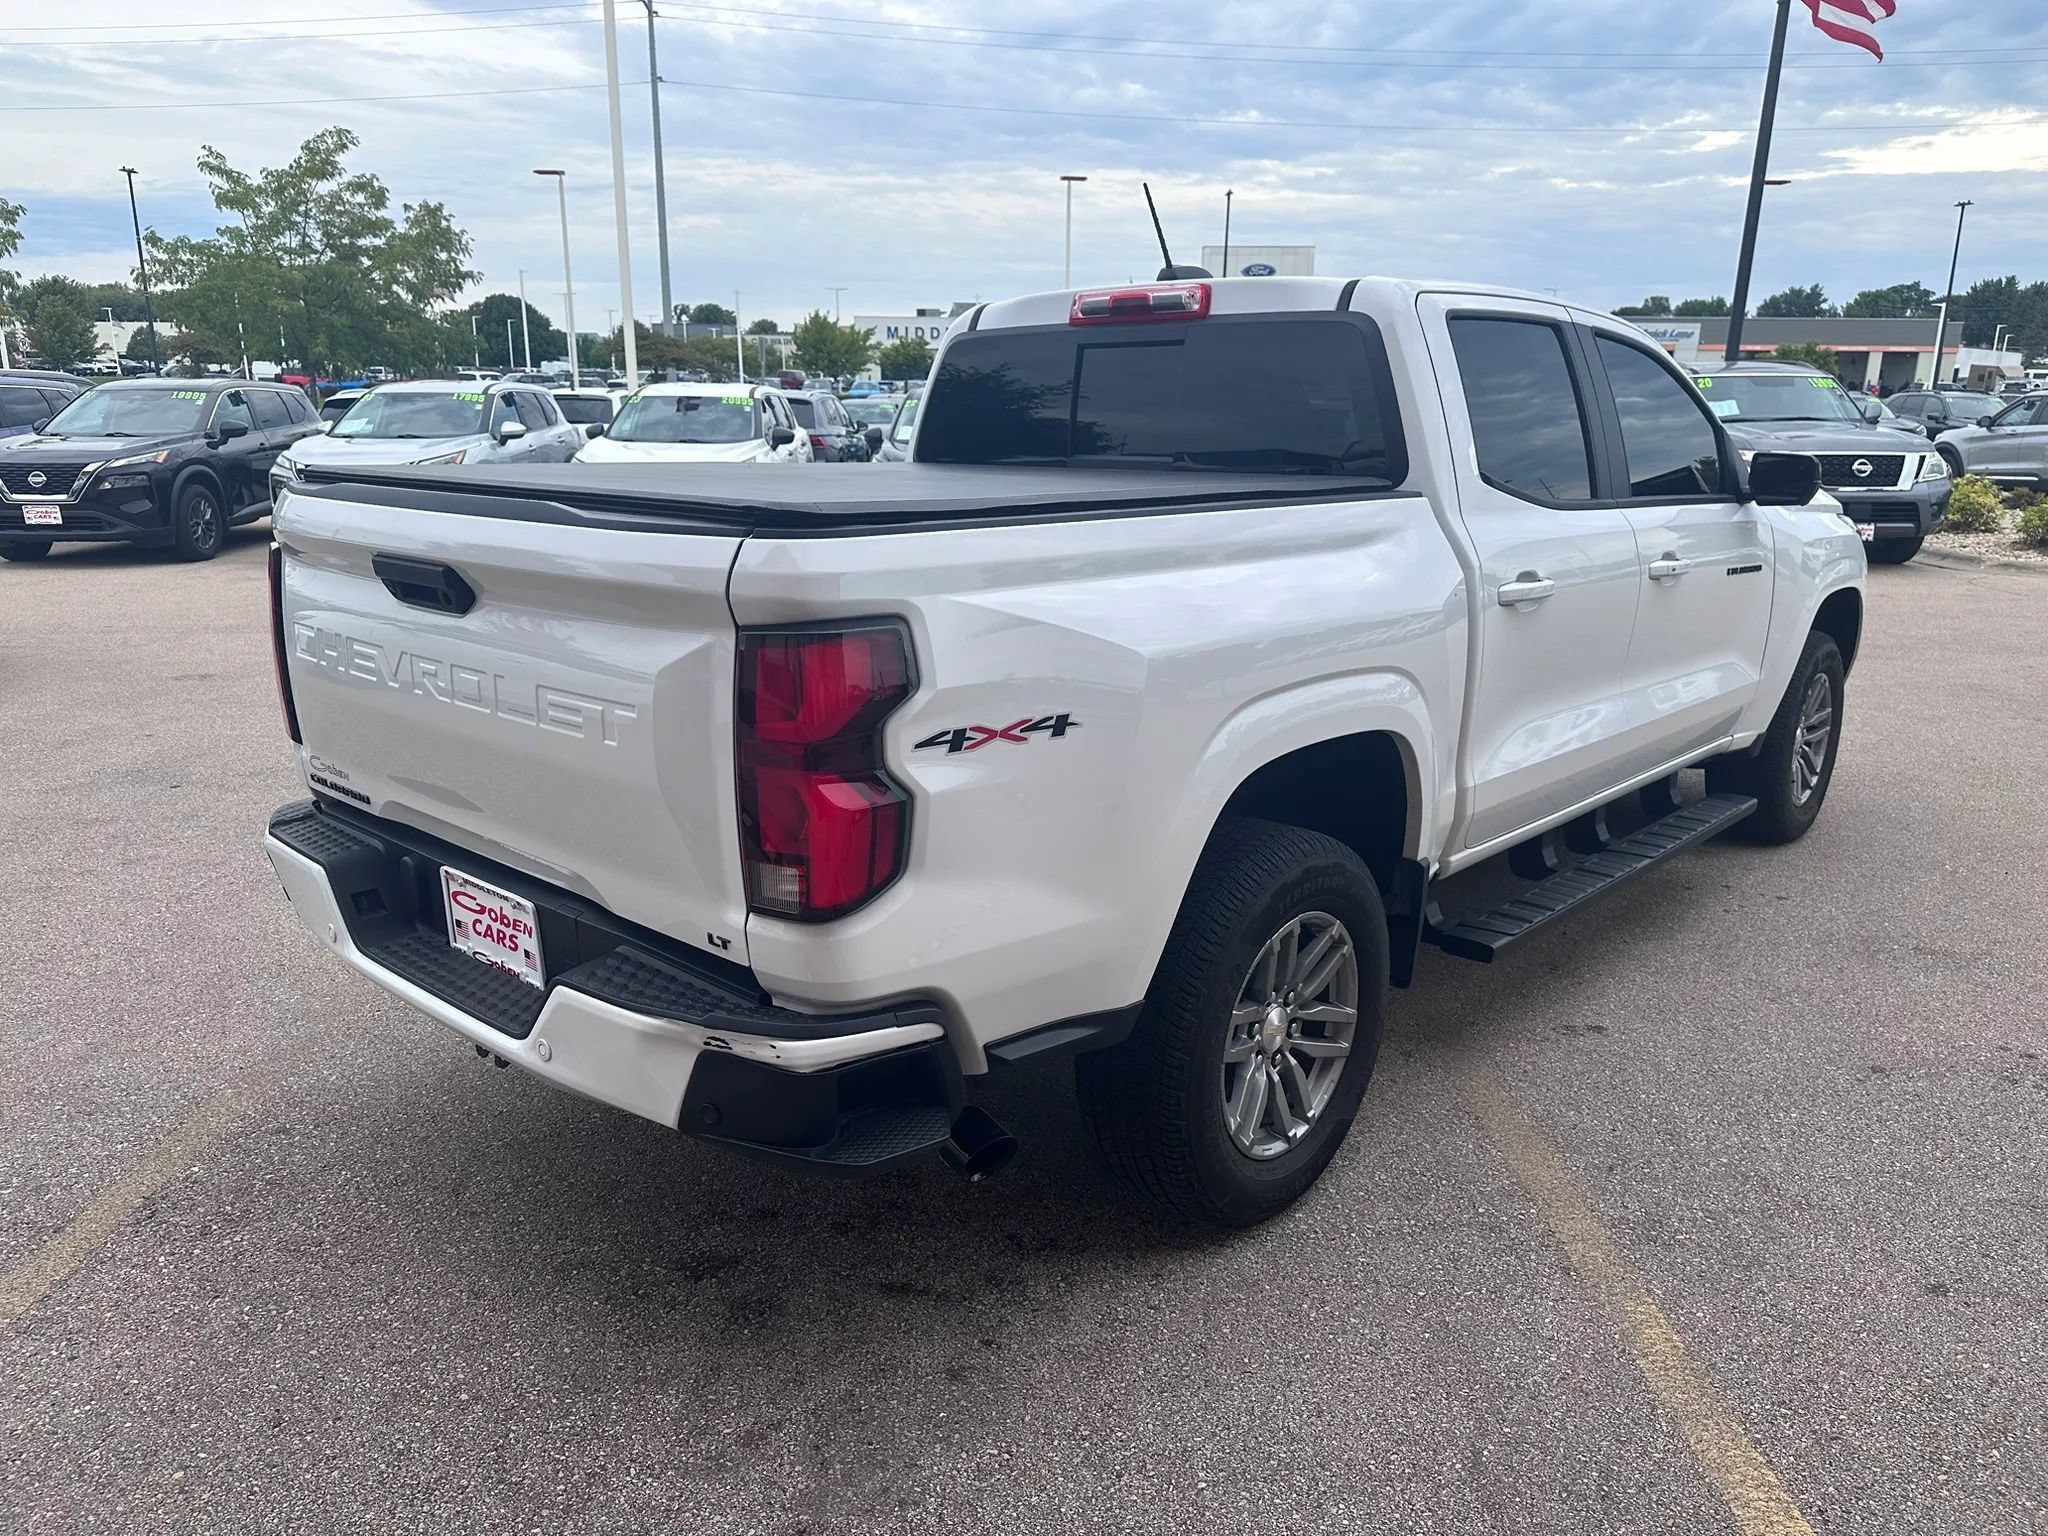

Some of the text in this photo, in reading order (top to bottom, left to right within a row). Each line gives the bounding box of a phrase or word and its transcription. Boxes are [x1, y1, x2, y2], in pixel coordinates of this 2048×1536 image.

[1248, 265, 1271, 277] Ford
[886, 325, 949, 340] MIDD
[1697, 378, 1712, 388] 20
[293, 621, 637, 746] CHEVROLET
[471, 917, 520, 953] CARS
[706, 931, 732, 951] LT
